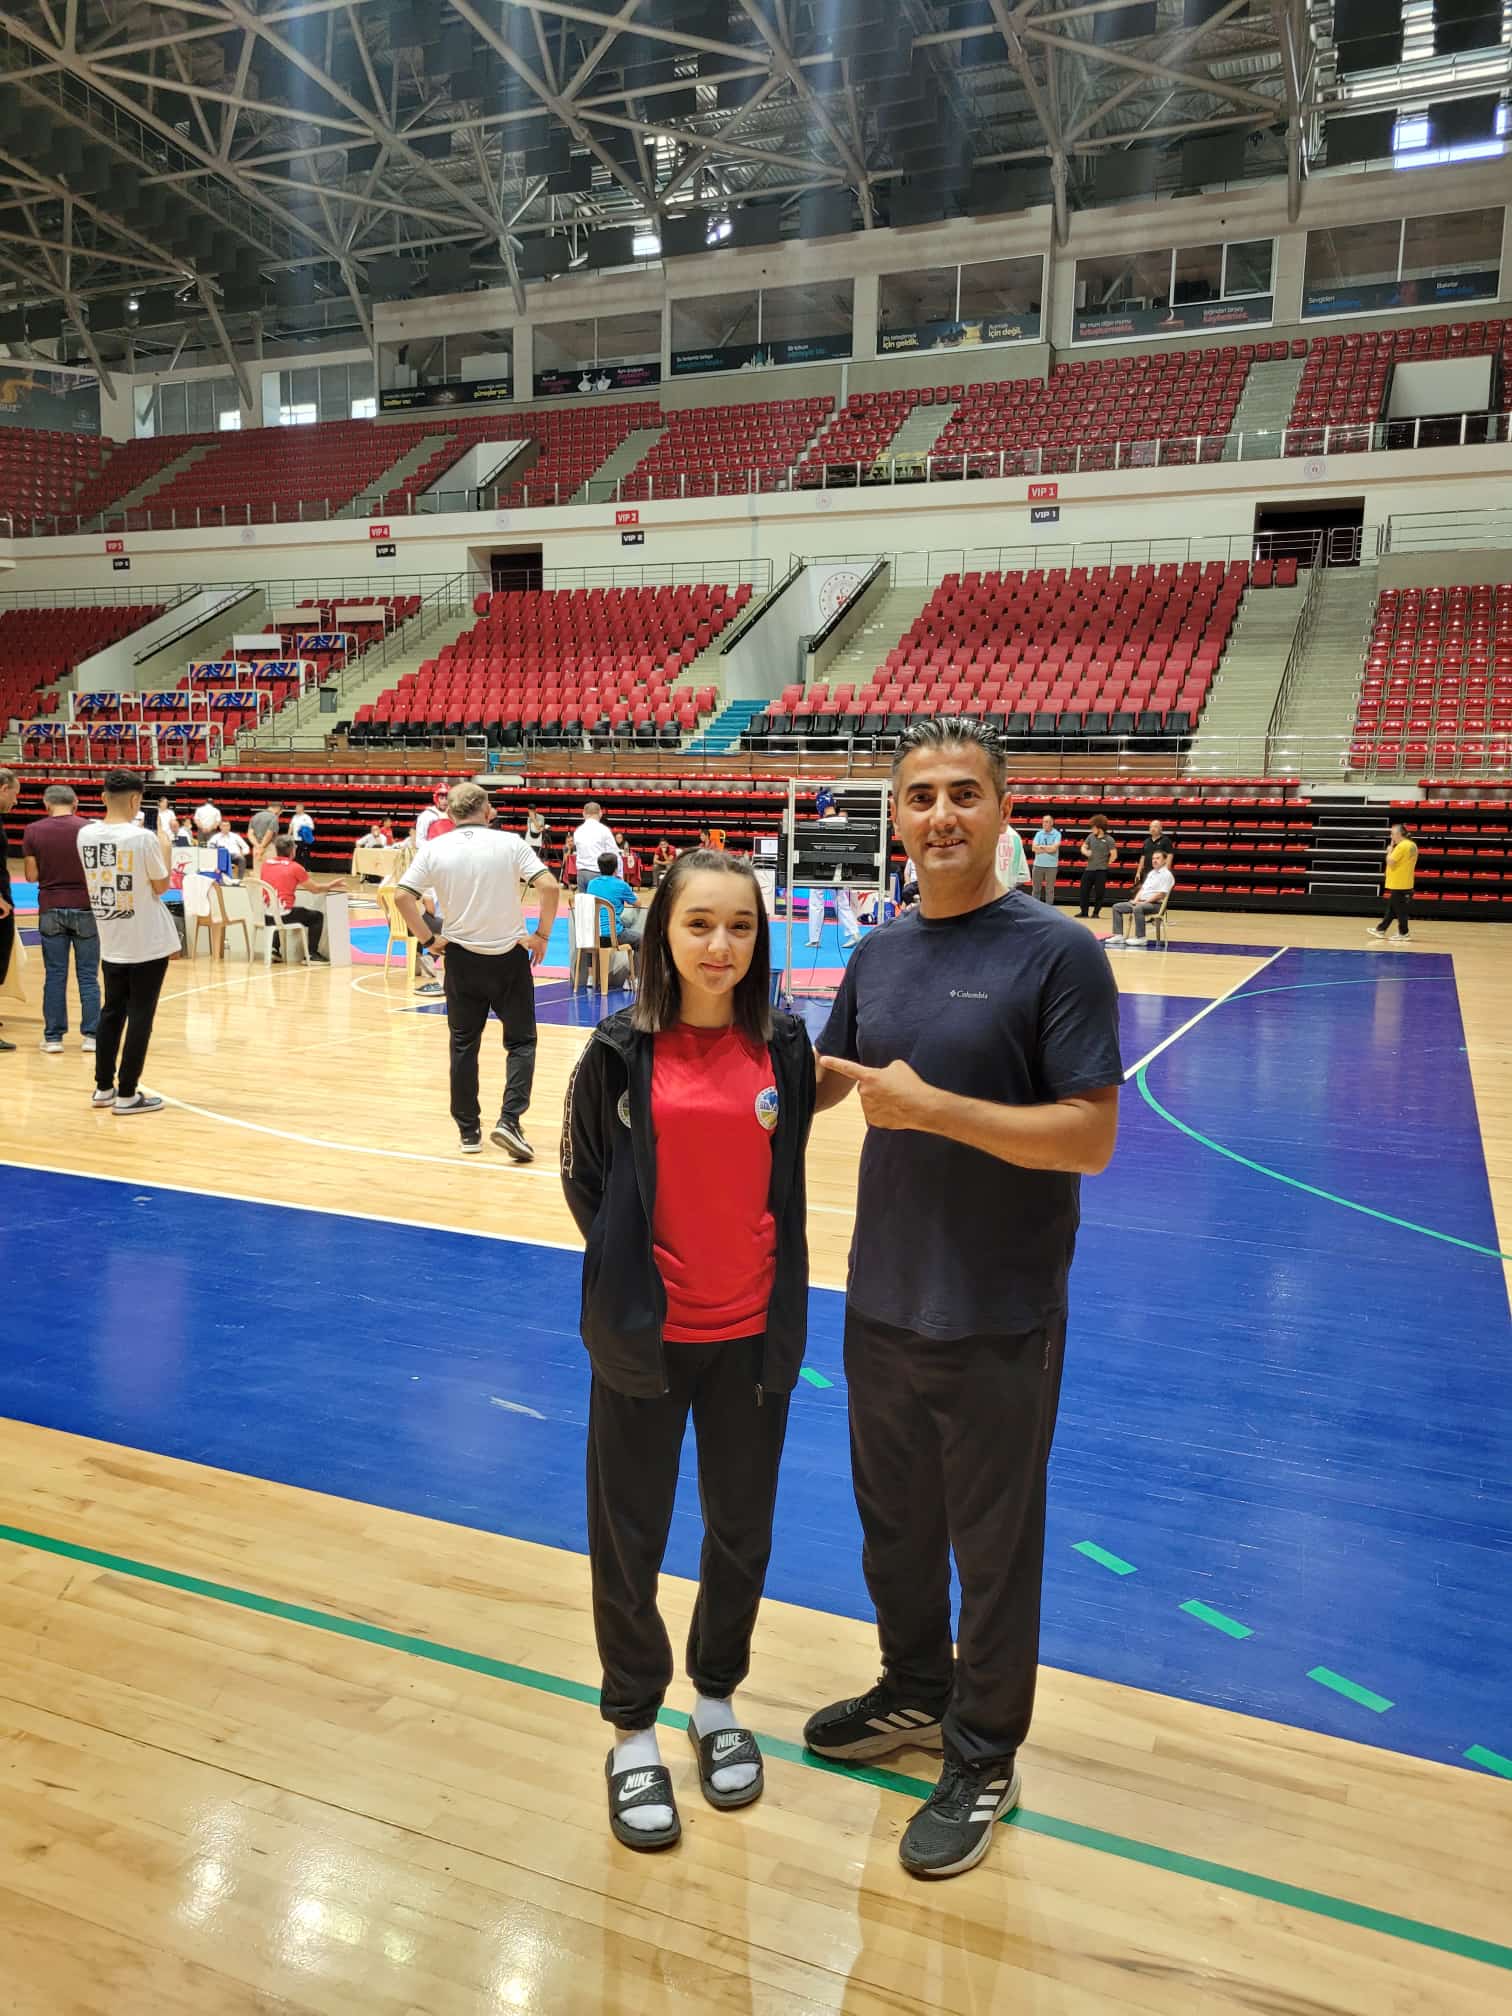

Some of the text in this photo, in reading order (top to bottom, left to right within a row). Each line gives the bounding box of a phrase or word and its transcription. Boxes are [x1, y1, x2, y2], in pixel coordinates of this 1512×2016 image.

[1032, 487, 1055, 497] VIP 1
[617, 512, 637, 522] VIP 2
[1034, 510, 1057, 519] VIP 1
[371, 527, 388, 537] VIP 4
[956, 990, 989, 1000] Columbia
[716, 1732, 741, 1749] NIKE
[624, 1771, 656, 1789] NIKE
